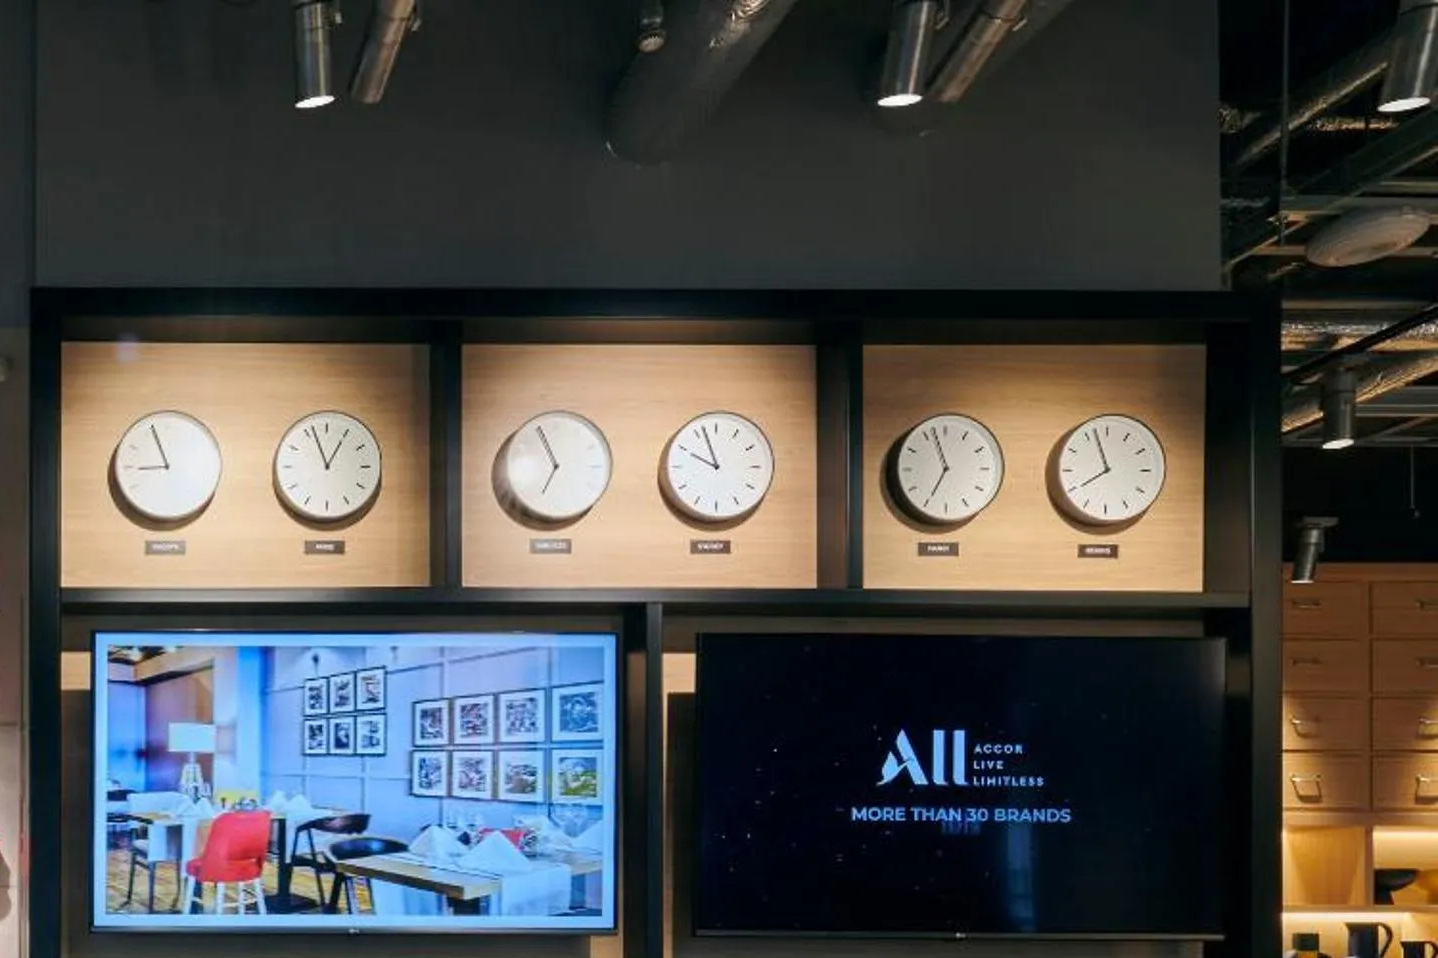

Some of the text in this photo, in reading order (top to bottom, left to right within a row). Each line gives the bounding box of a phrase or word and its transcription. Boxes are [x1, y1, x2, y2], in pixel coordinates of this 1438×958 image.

[973, 744, 1023, 754] ACCOR
[973, 760, 1004, 770] LIVE
[973, 776, 1045, 787] LIMITLESS
[851, 807, 1072, 823] MORE THAN 30 BRANDS
